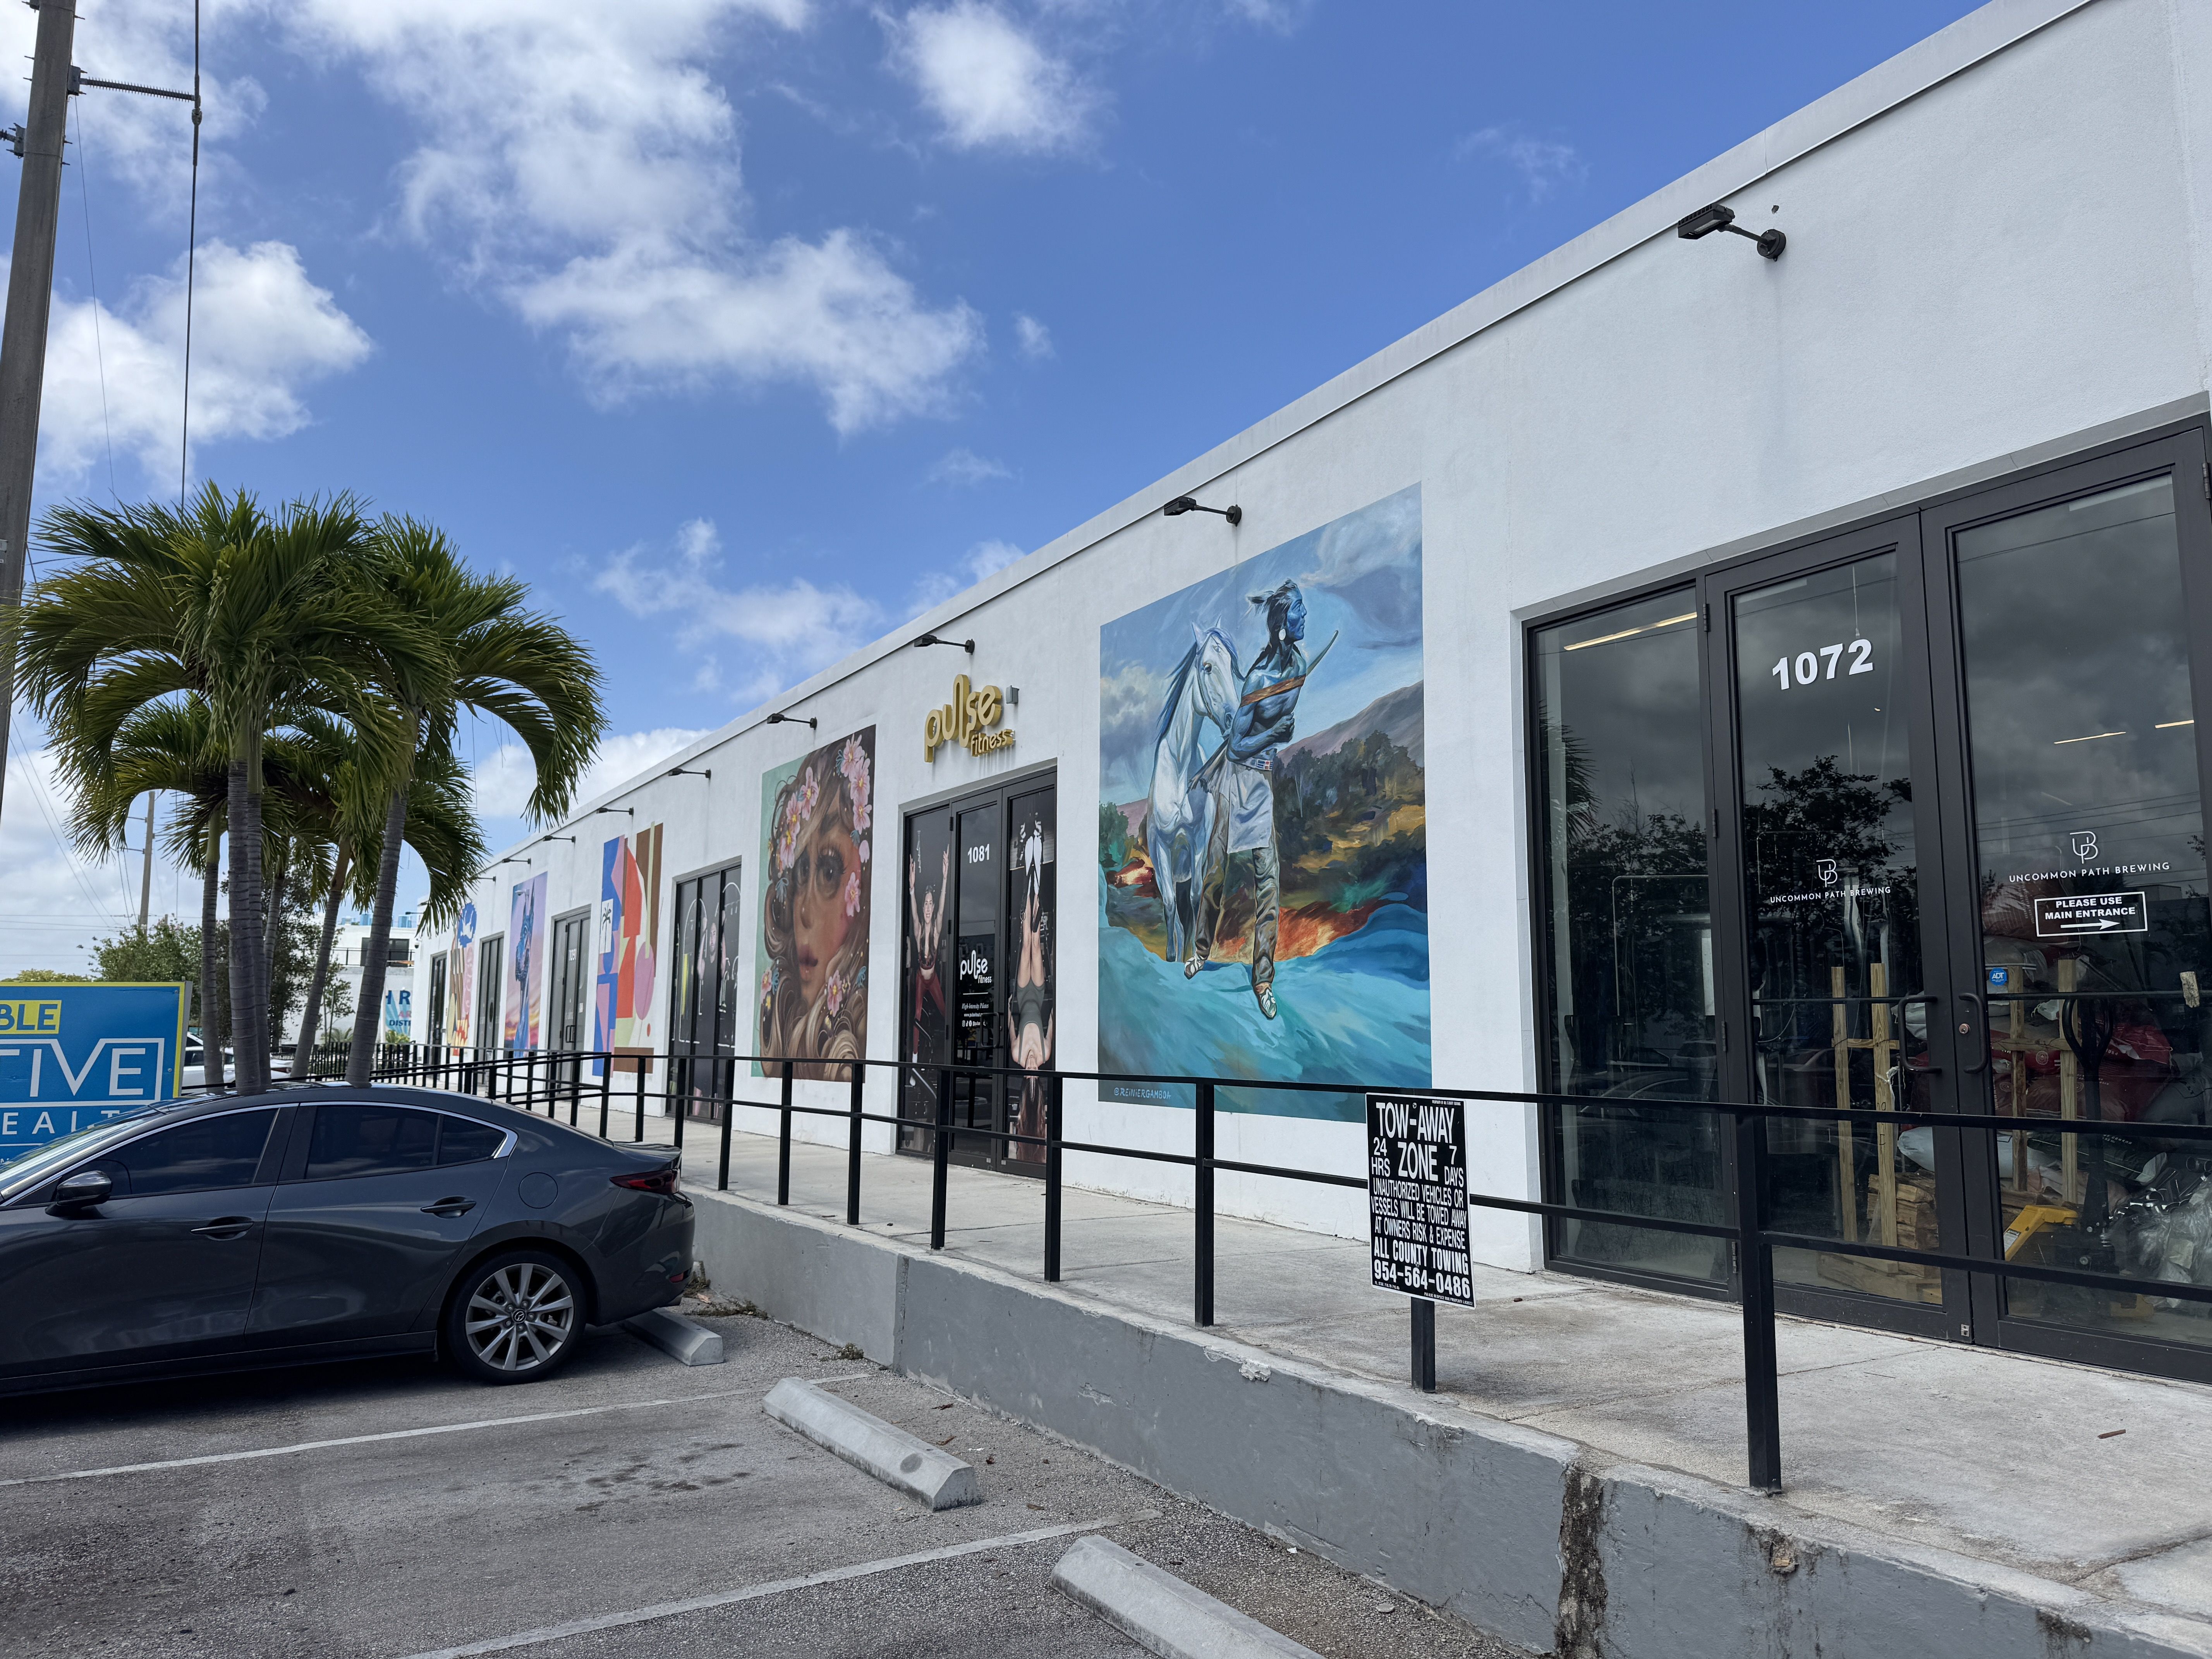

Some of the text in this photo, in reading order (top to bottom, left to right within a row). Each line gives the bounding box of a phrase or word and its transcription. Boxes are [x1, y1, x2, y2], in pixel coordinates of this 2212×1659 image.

[1772, 639, 1873, 690] 1072
[924, 674, 1002, 763] pulse
[971, 729, 1013, 757] fitness
[968, 843, 990, 864] 1081
[2009, 862, 2170, 883] UNCOMMON PATH BREWING
[1770, 893, 1821, 903] UNCOMMON
[1850, 886, 1891, 896] BREWING
[2056, 896, 2122, 908] PLEASE USE
[2045, 907, 2136, 920] MAIN ENTRANCE
[960, 950, 988, 980] pulse
[0, 1004, 58, 1030] BLE
[1376, 1102, 1455, 1144] TOW-AWAY
[1374, 1137, 1387, 1156] 24
[1449, 1145, 1457, 1165] 7
[1371, 1157, 1391, 1177] HRS
[1398, 1142, 1438, 1182] ZONE
[1444, 1166, 1464, 1187] DAYS
[1373, 1177, 1463, 1208] UNAUTHORIZED VEHICLES OR
[1371, 1196, 1467, 1229] VESSELS WILL BE TOWED AWAY
[1375, 1216, 1466, 1250] AT OWNERS RISK & EXPENSE
[1374, 1236, 1469, 1275] ALL COUNTY TOWING
[1374, 1259, 1470, 1298] 954-564-0486
